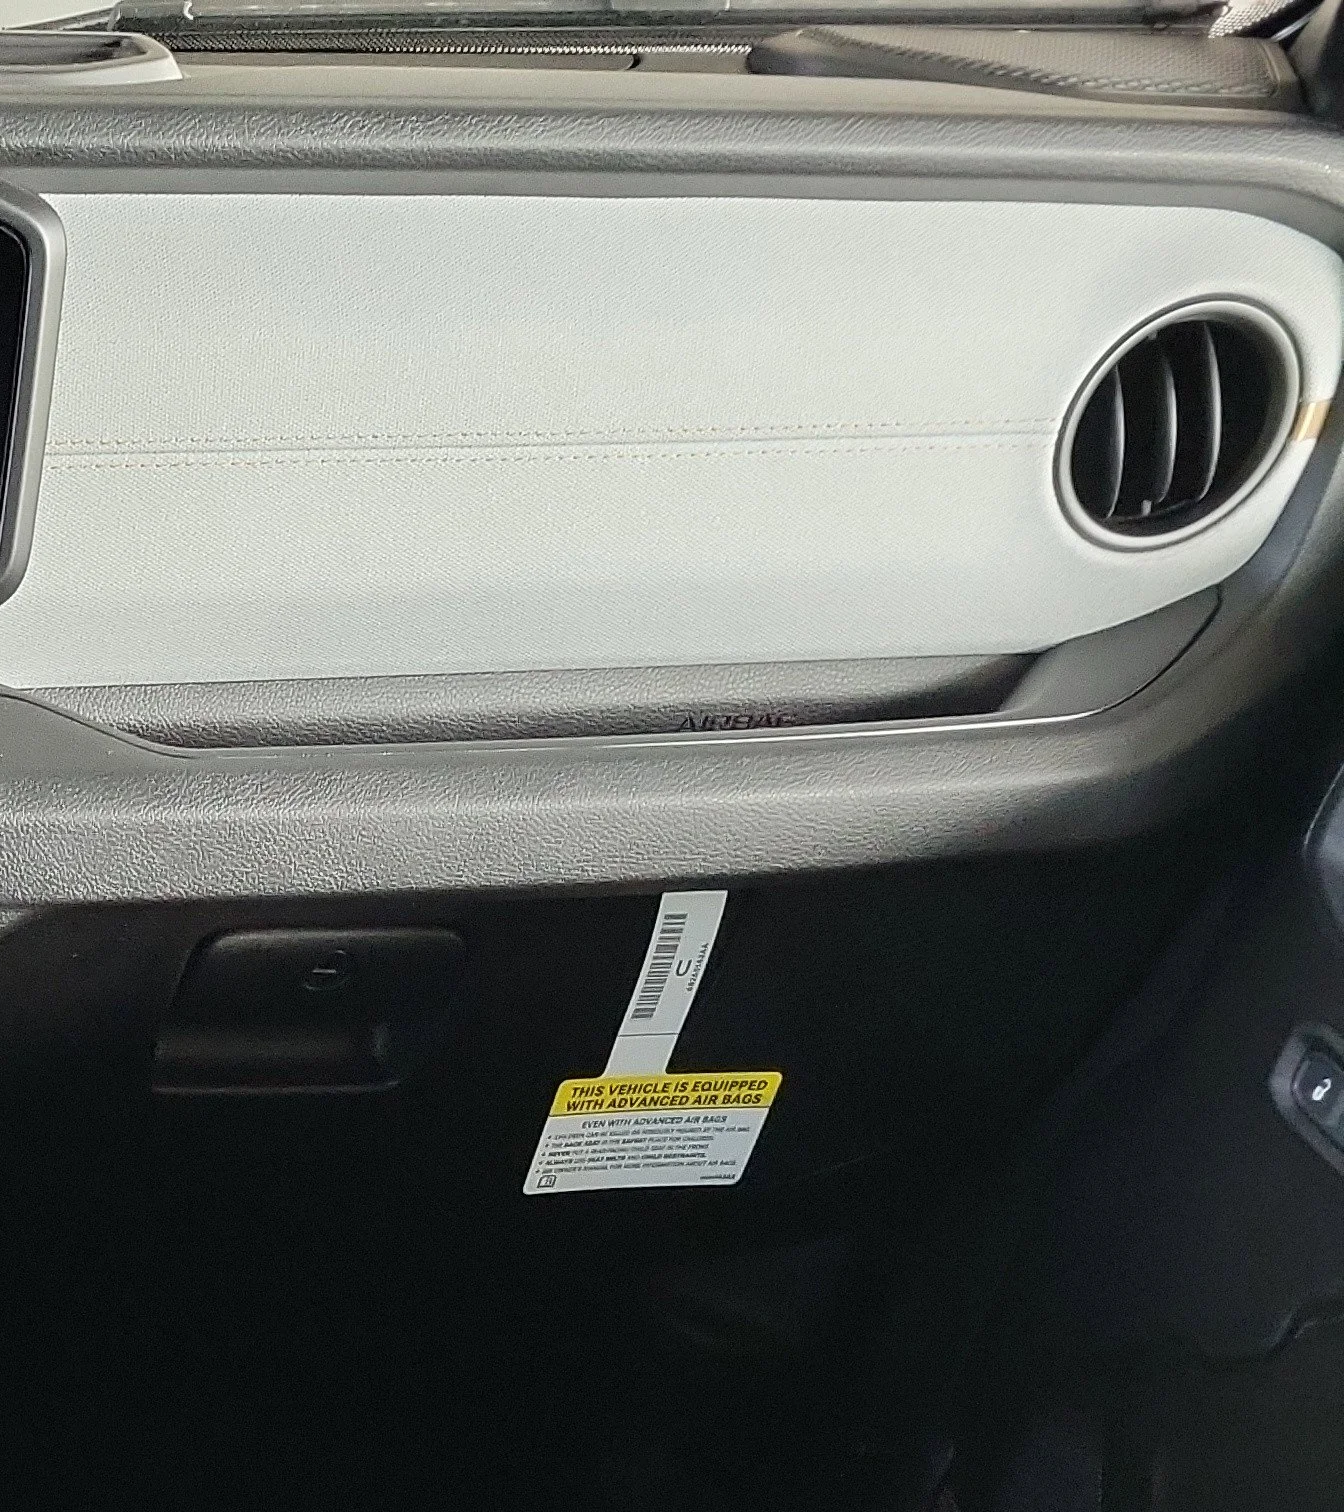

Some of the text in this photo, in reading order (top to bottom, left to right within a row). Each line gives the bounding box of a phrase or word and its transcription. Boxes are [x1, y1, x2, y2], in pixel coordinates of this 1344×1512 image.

[571, 1079, 769, 1099] THIS VEHICLE IS EQUIPPED
[566, 1093, 763, 1112] WITH ADVANCED AIR BAGS
[581, 1115, 728, 1130] EVEN WITH ADVANCED AIR BAGS
